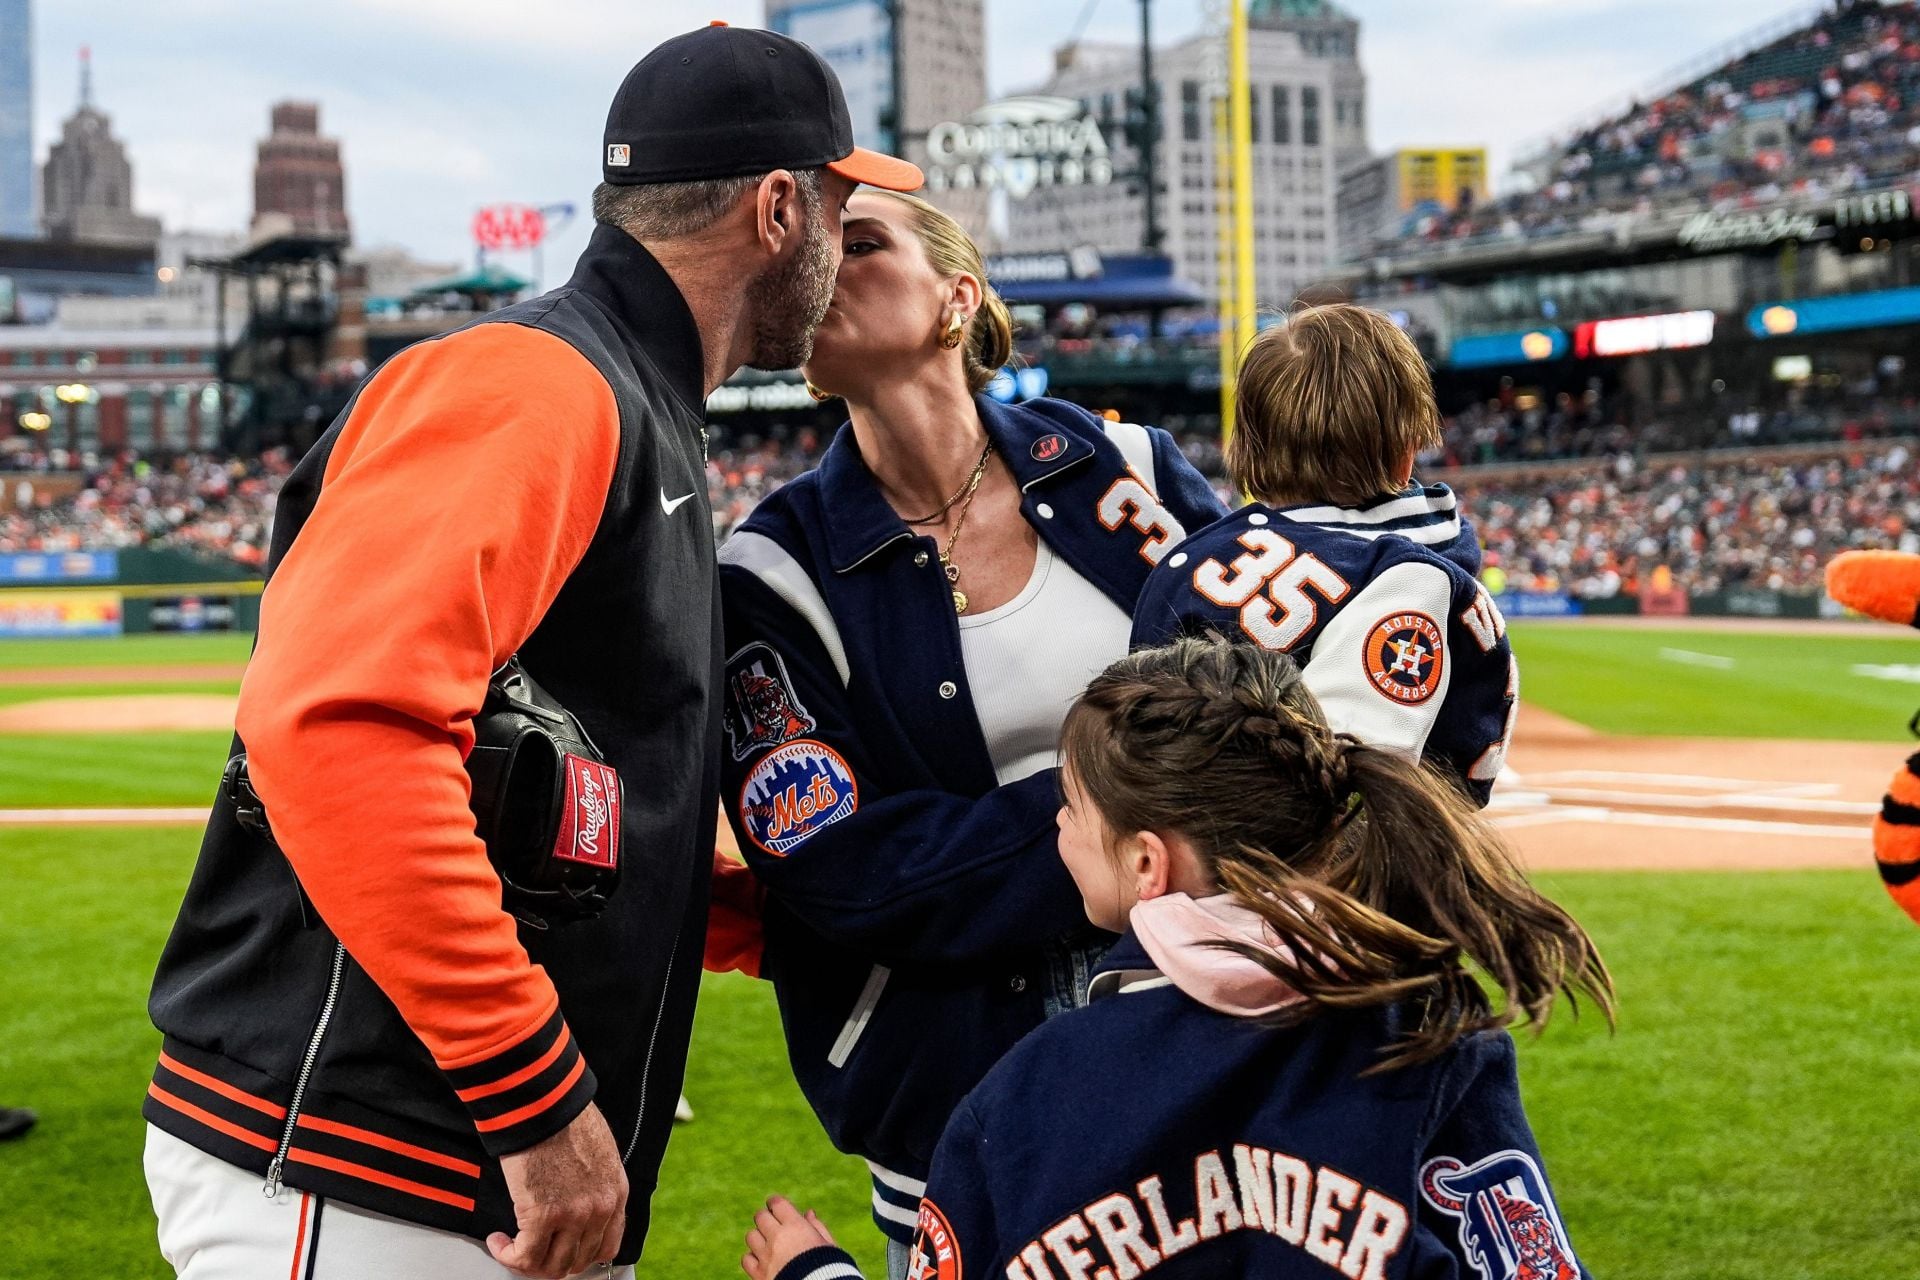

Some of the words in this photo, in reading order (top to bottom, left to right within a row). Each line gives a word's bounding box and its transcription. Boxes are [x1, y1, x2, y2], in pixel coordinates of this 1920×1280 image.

[1193, 528, 1351, 652] 35
[1382, 615, 1441, 650] HOUSTON
[1391, 638, 1427, 677] H
[1373, 671, 1428, 699] ASTROS
[578, 767, 601, 855] Rawlings
[767, 773, 839, 839] Mets
